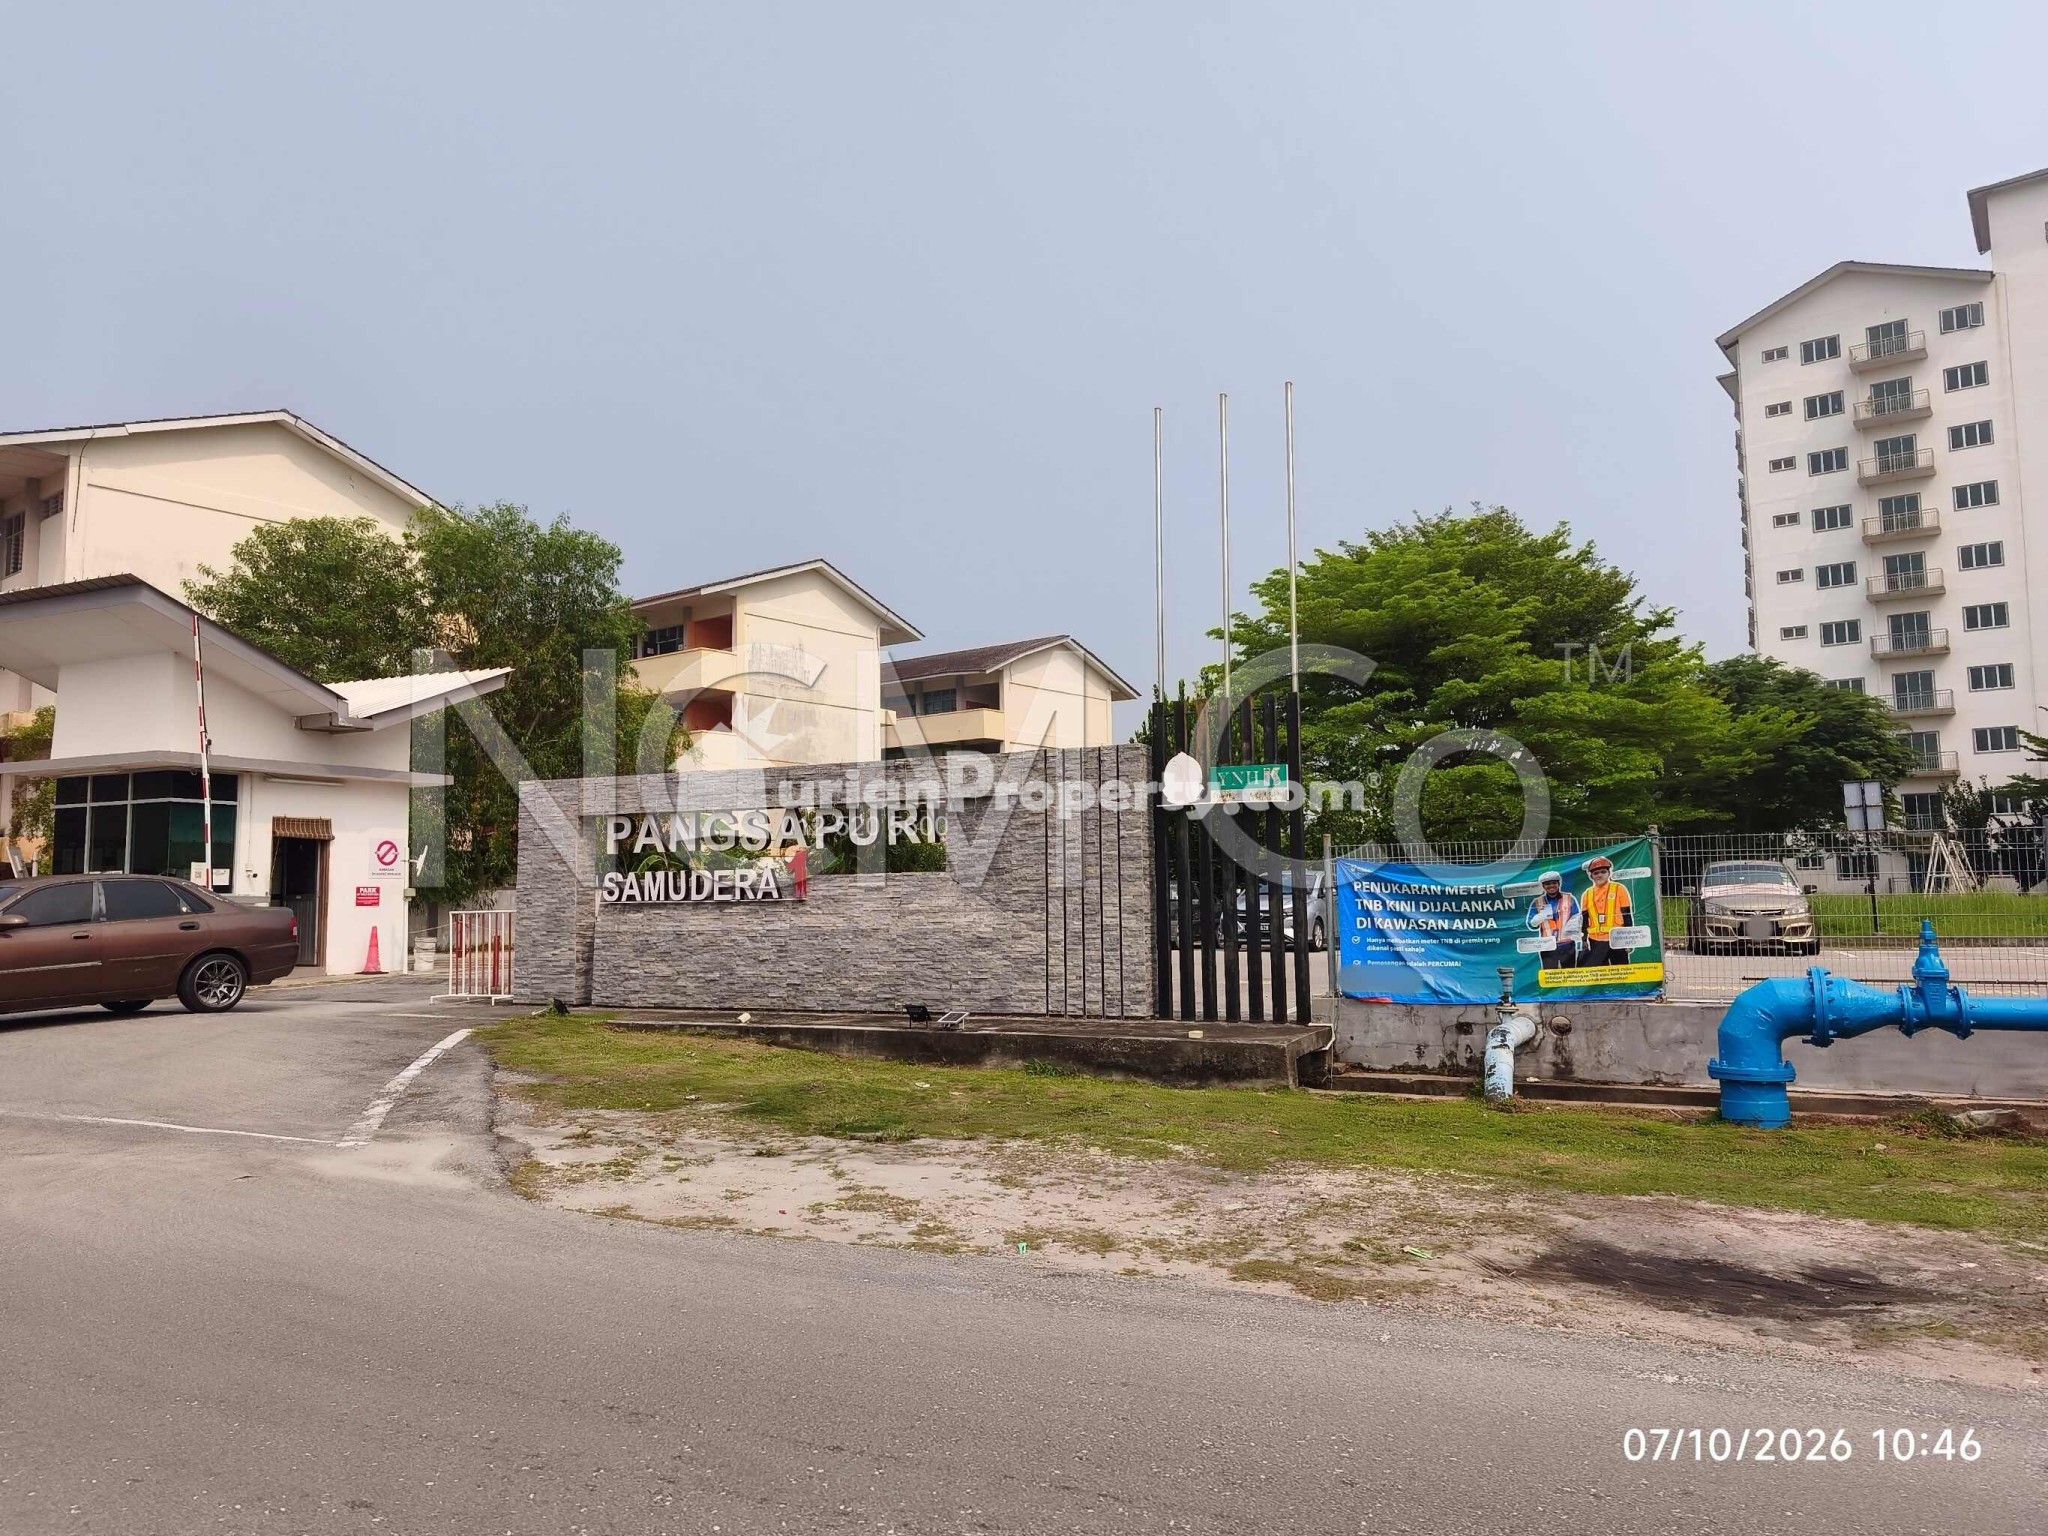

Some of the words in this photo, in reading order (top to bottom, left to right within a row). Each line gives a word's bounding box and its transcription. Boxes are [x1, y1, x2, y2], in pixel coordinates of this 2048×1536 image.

[606, 800, 937, 855] PANGSAPURI
[602, 867, 781, 902] SAMUDERA
[783, 845, 808, 899] 1
[1353, 881, 1442, 896] PENUKARAN
[1445, 884, 1496, 896] METER
[1355, 898, 1382, 911] TNB
[1386, 899, 1416, 912] KINI
[1419, 898, 1516, 912] DIJALANKAN
[1356, 917, 1371, 929] DI
[1374, 917, 1449, 930] KAWASAN
[1452, 917, 1498, 929] ANDA
